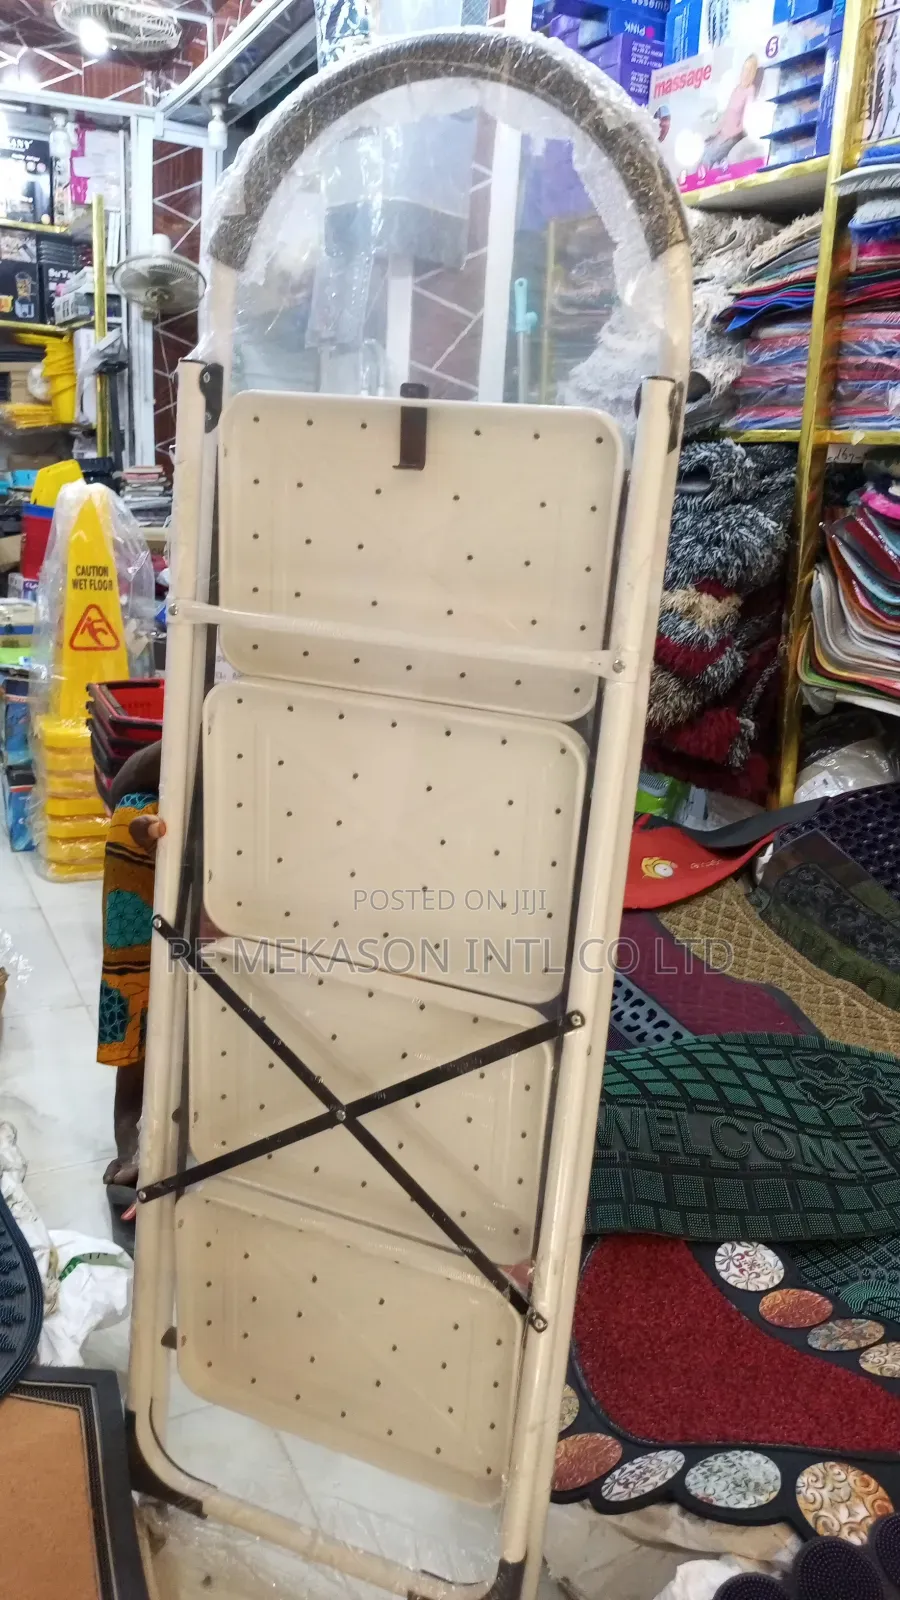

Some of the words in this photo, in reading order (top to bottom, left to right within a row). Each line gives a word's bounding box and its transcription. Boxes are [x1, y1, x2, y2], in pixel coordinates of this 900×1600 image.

[653, 63, 713, 99] massage
[75, 564, 109, 577] CAUTION
[71, 578, 88, 590] WET
[89, 578, 113, 591] FLOOR
